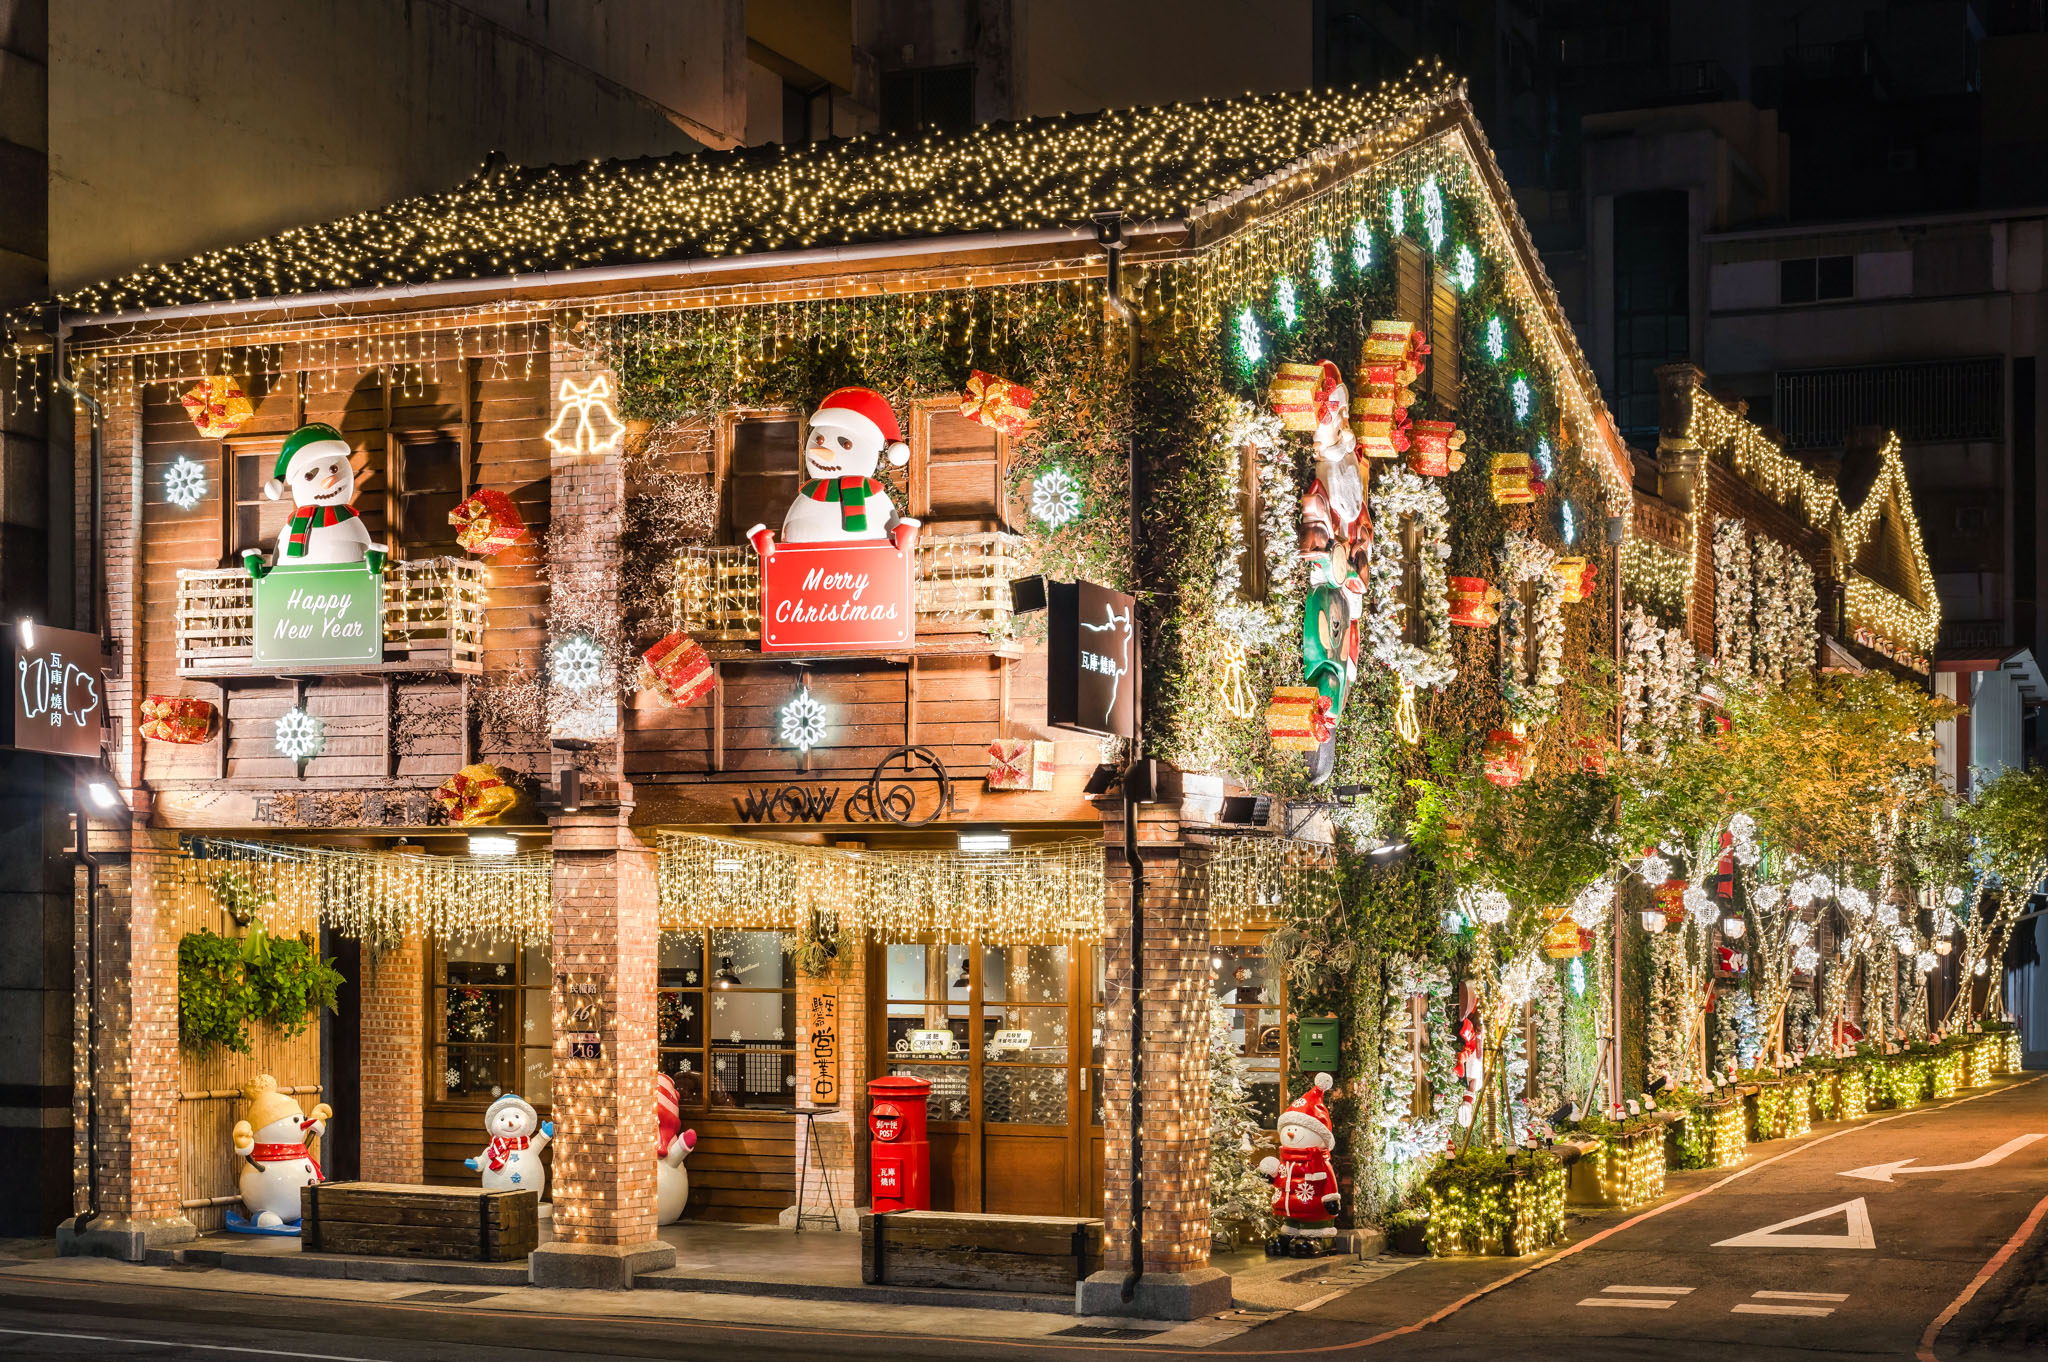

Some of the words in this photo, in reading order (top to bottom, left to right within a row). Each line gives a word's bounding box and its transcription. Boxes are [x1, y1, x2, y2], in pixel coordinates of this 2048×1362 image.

[802, 568, 870, 600] Merry
[287, 588, 352, 619] Happy
[775, 598, 898, 623] Christmas
[273, 618, 313, 639] New
[321, 617, 364, 638] Year
[748, 784, 840, 817] WOW
[580, 1044, 595, 1058] 16
[879, 1129, 894, 1138] POST
